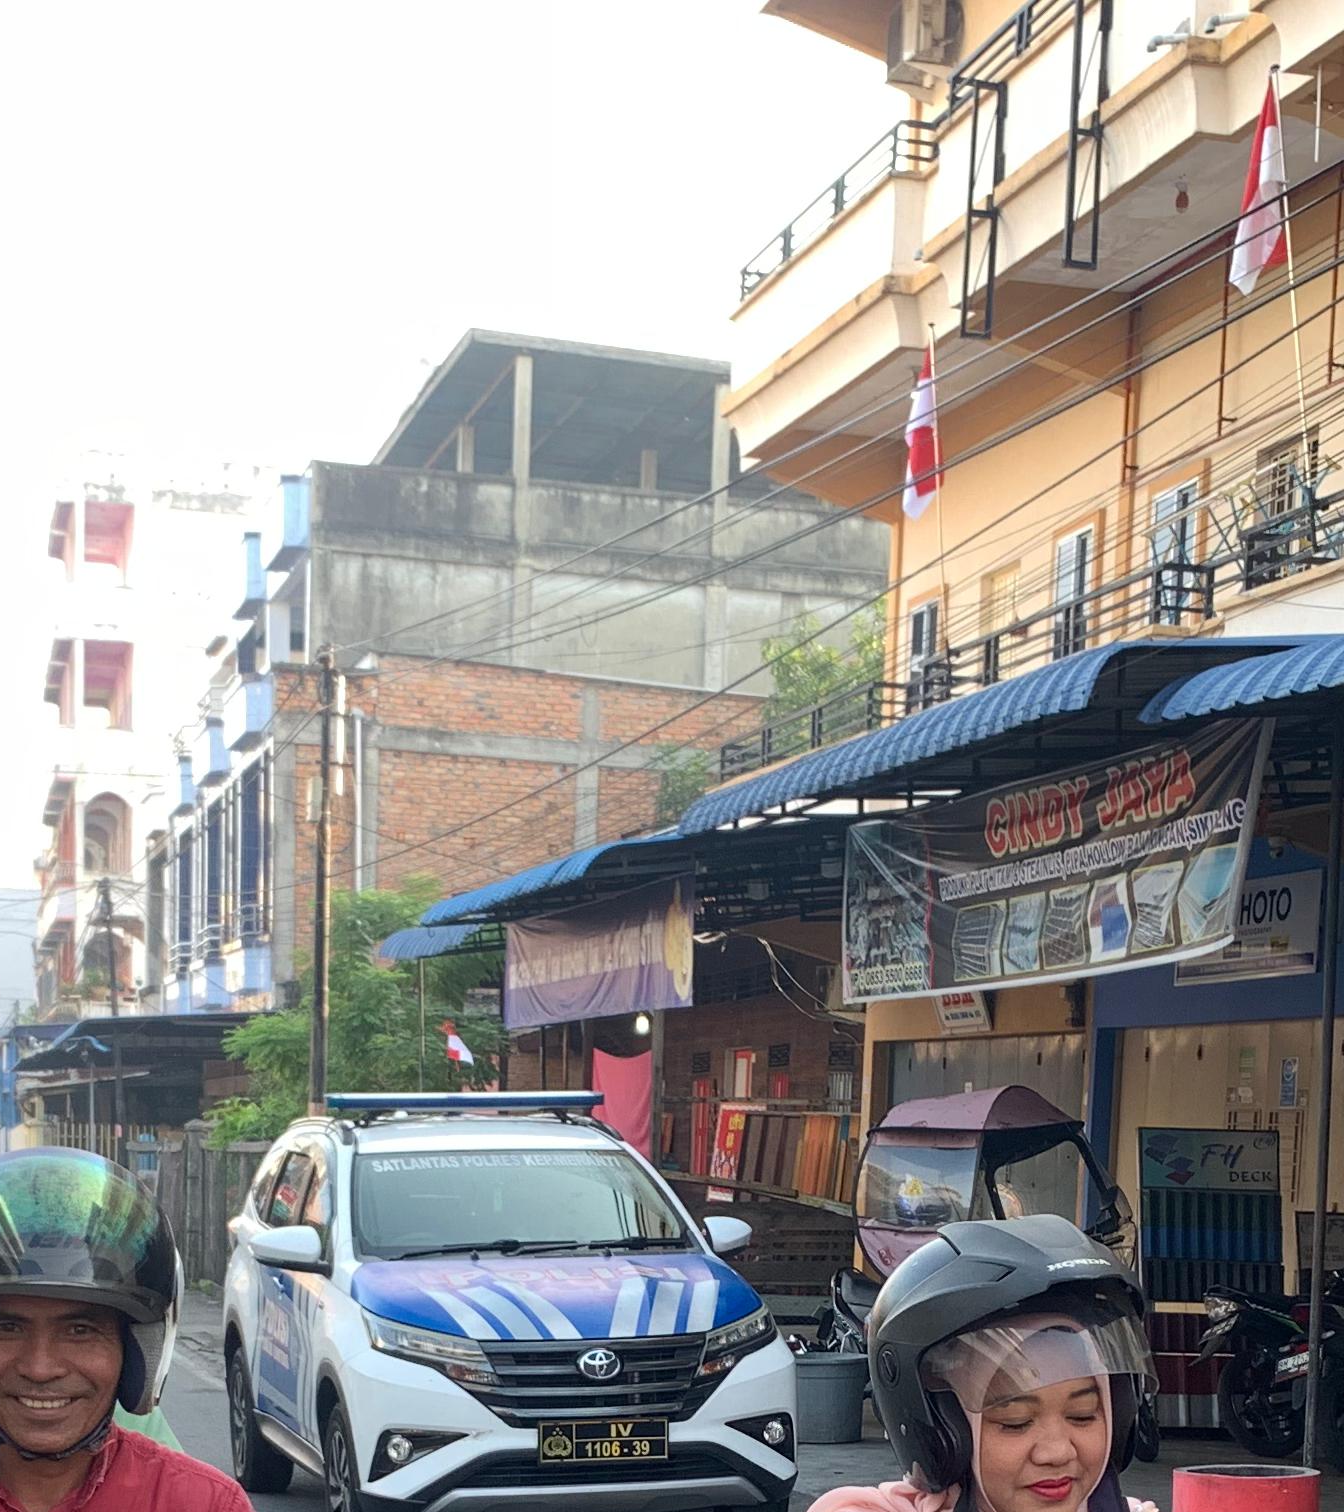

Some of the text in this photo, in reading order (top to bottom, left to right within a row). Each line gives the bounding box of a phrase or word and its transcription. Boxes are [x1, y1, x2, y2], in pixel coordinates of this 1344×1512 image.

[985, 751, 1196, 858] CINDY JAYA
[1240, 886, 1292, 926] HOTO
[372, 1155, 458, 1173] SATLANTAS
[462, 1154, 521, 1168] POLRES
[1200, 1142, 1244, 1169] FH
[1229, 1170, 1273, 1183] DECK
[1047, 1257, 1112, 1272] HONDA
[449, 1266, 690, 1289] POLISI
[610, 1423, 634, 1438] IV
